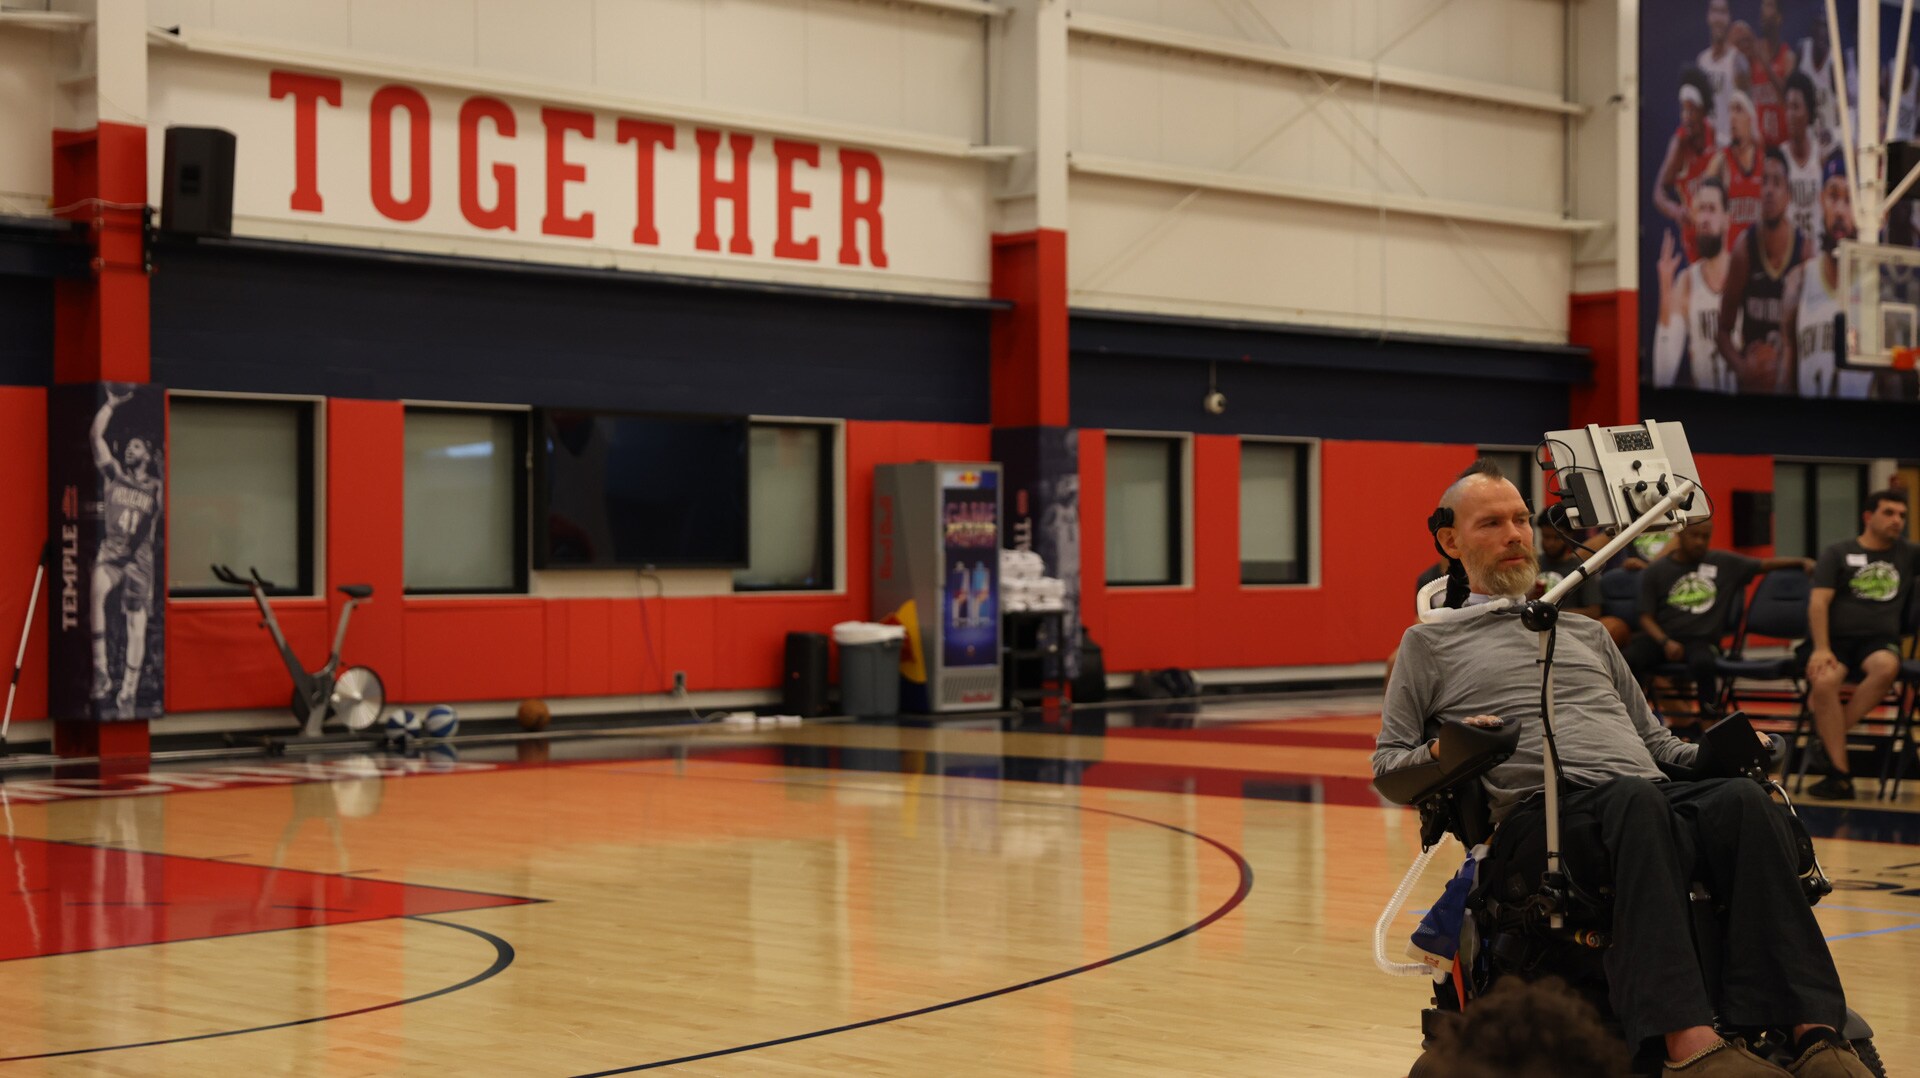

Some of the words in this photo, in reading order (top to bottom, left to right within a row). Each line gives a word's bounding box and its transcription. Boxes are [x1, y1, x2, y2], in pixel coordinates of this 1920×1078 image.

[270, 69, 888, 269] TOGETHER
[118, 509, 140, 535] 41
[62, 524, 79, 632] TEMPLE
